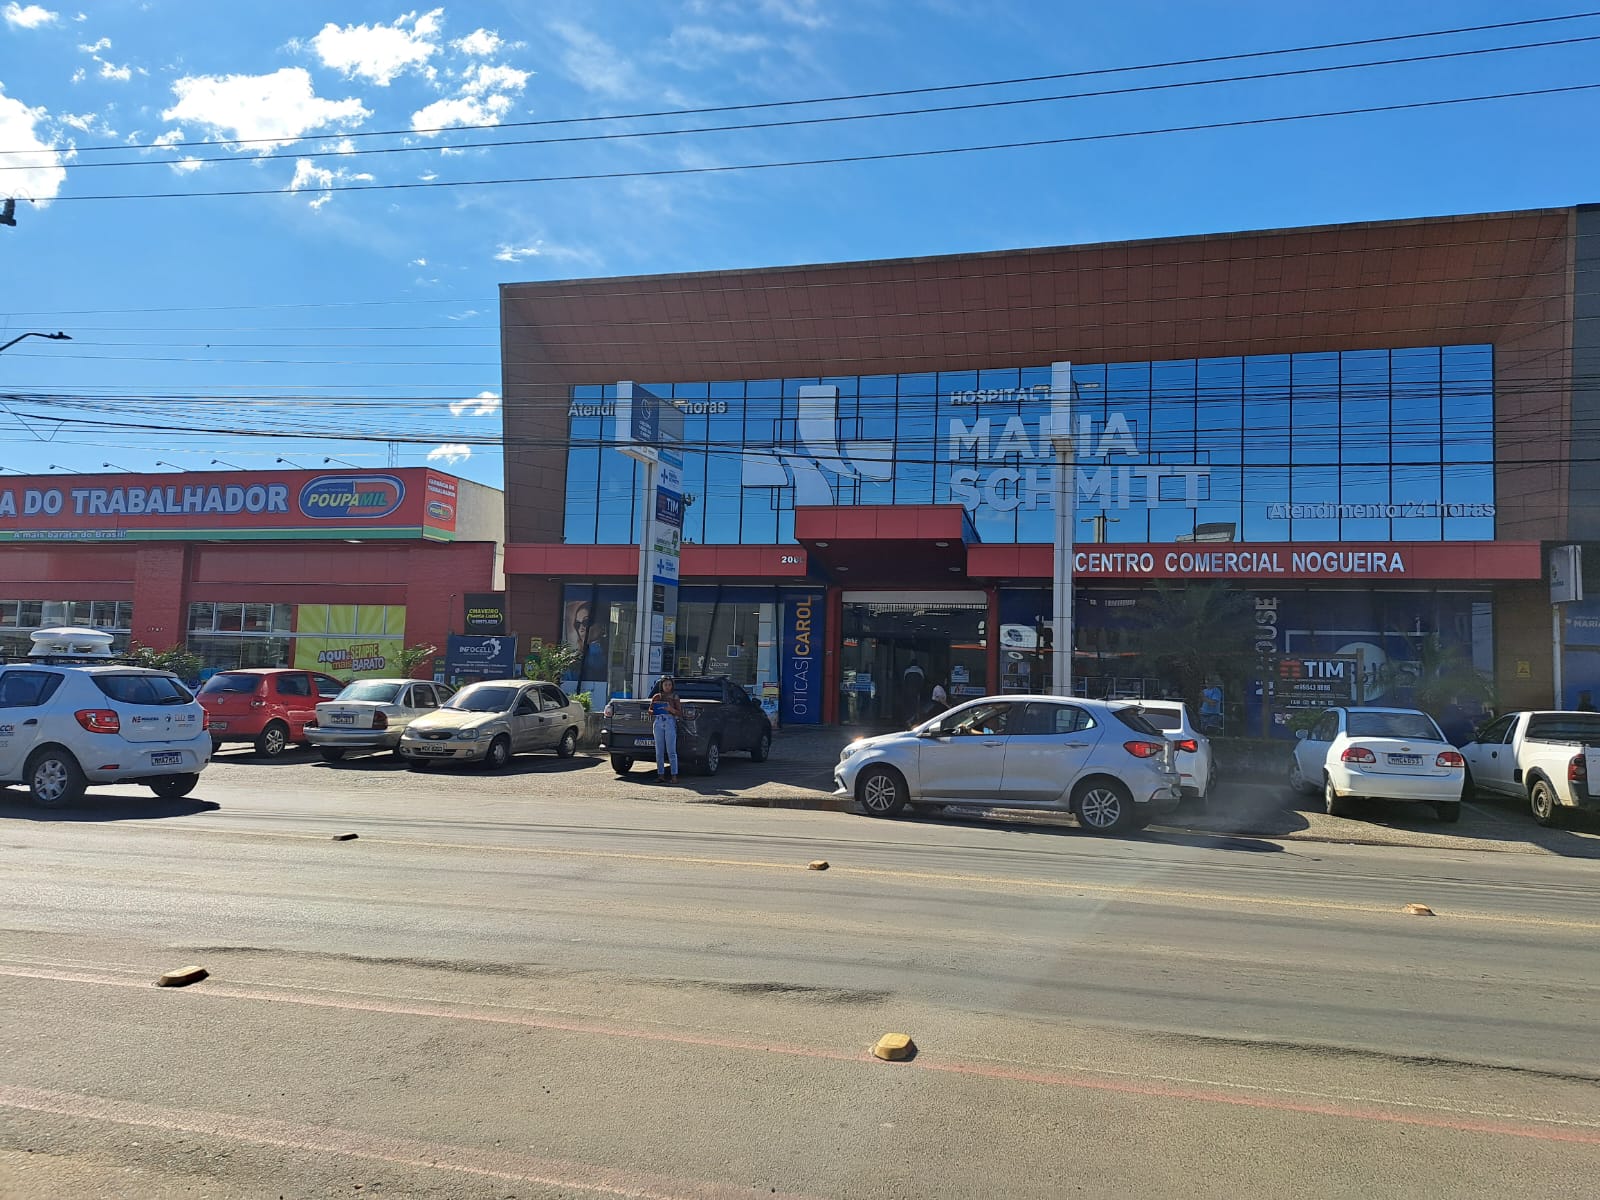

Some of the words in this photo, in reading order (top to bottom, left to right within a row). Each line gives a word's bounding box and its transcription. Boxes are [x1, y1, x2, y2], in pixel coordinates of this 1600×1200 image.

[951, 387, 1039, 405] HOSPITAL
[950, 465, 1211, 512] SCHMITT
[23, 488, 64, 516] DO
[71, 485, 289, 516] TRABALHADOR
[307, 491, 388, 508] POUPAMIL
[1267, 503, 1400, 519] Atendimento
[1405, 501, 1427, 518] 24
[1436, 501, 1496, 517] horas
[1075, 552, 1155, 573] CENTRO
[1164, 552, 1284, 573] COMERCIAL
[1292, 552, 1405, 573] NOGUEIRA
[795, 595, 813, 656] CAROL
[318, 650, 346, 663] AQUI
[351, 644, 378, 659] SEMPRE
[332, 660, 353, 669] mais
[352, 657, 385, 671] BARATO
[1304, 661, 1344, 678] TIM
[793, 660, 809, 715] OTICAS
